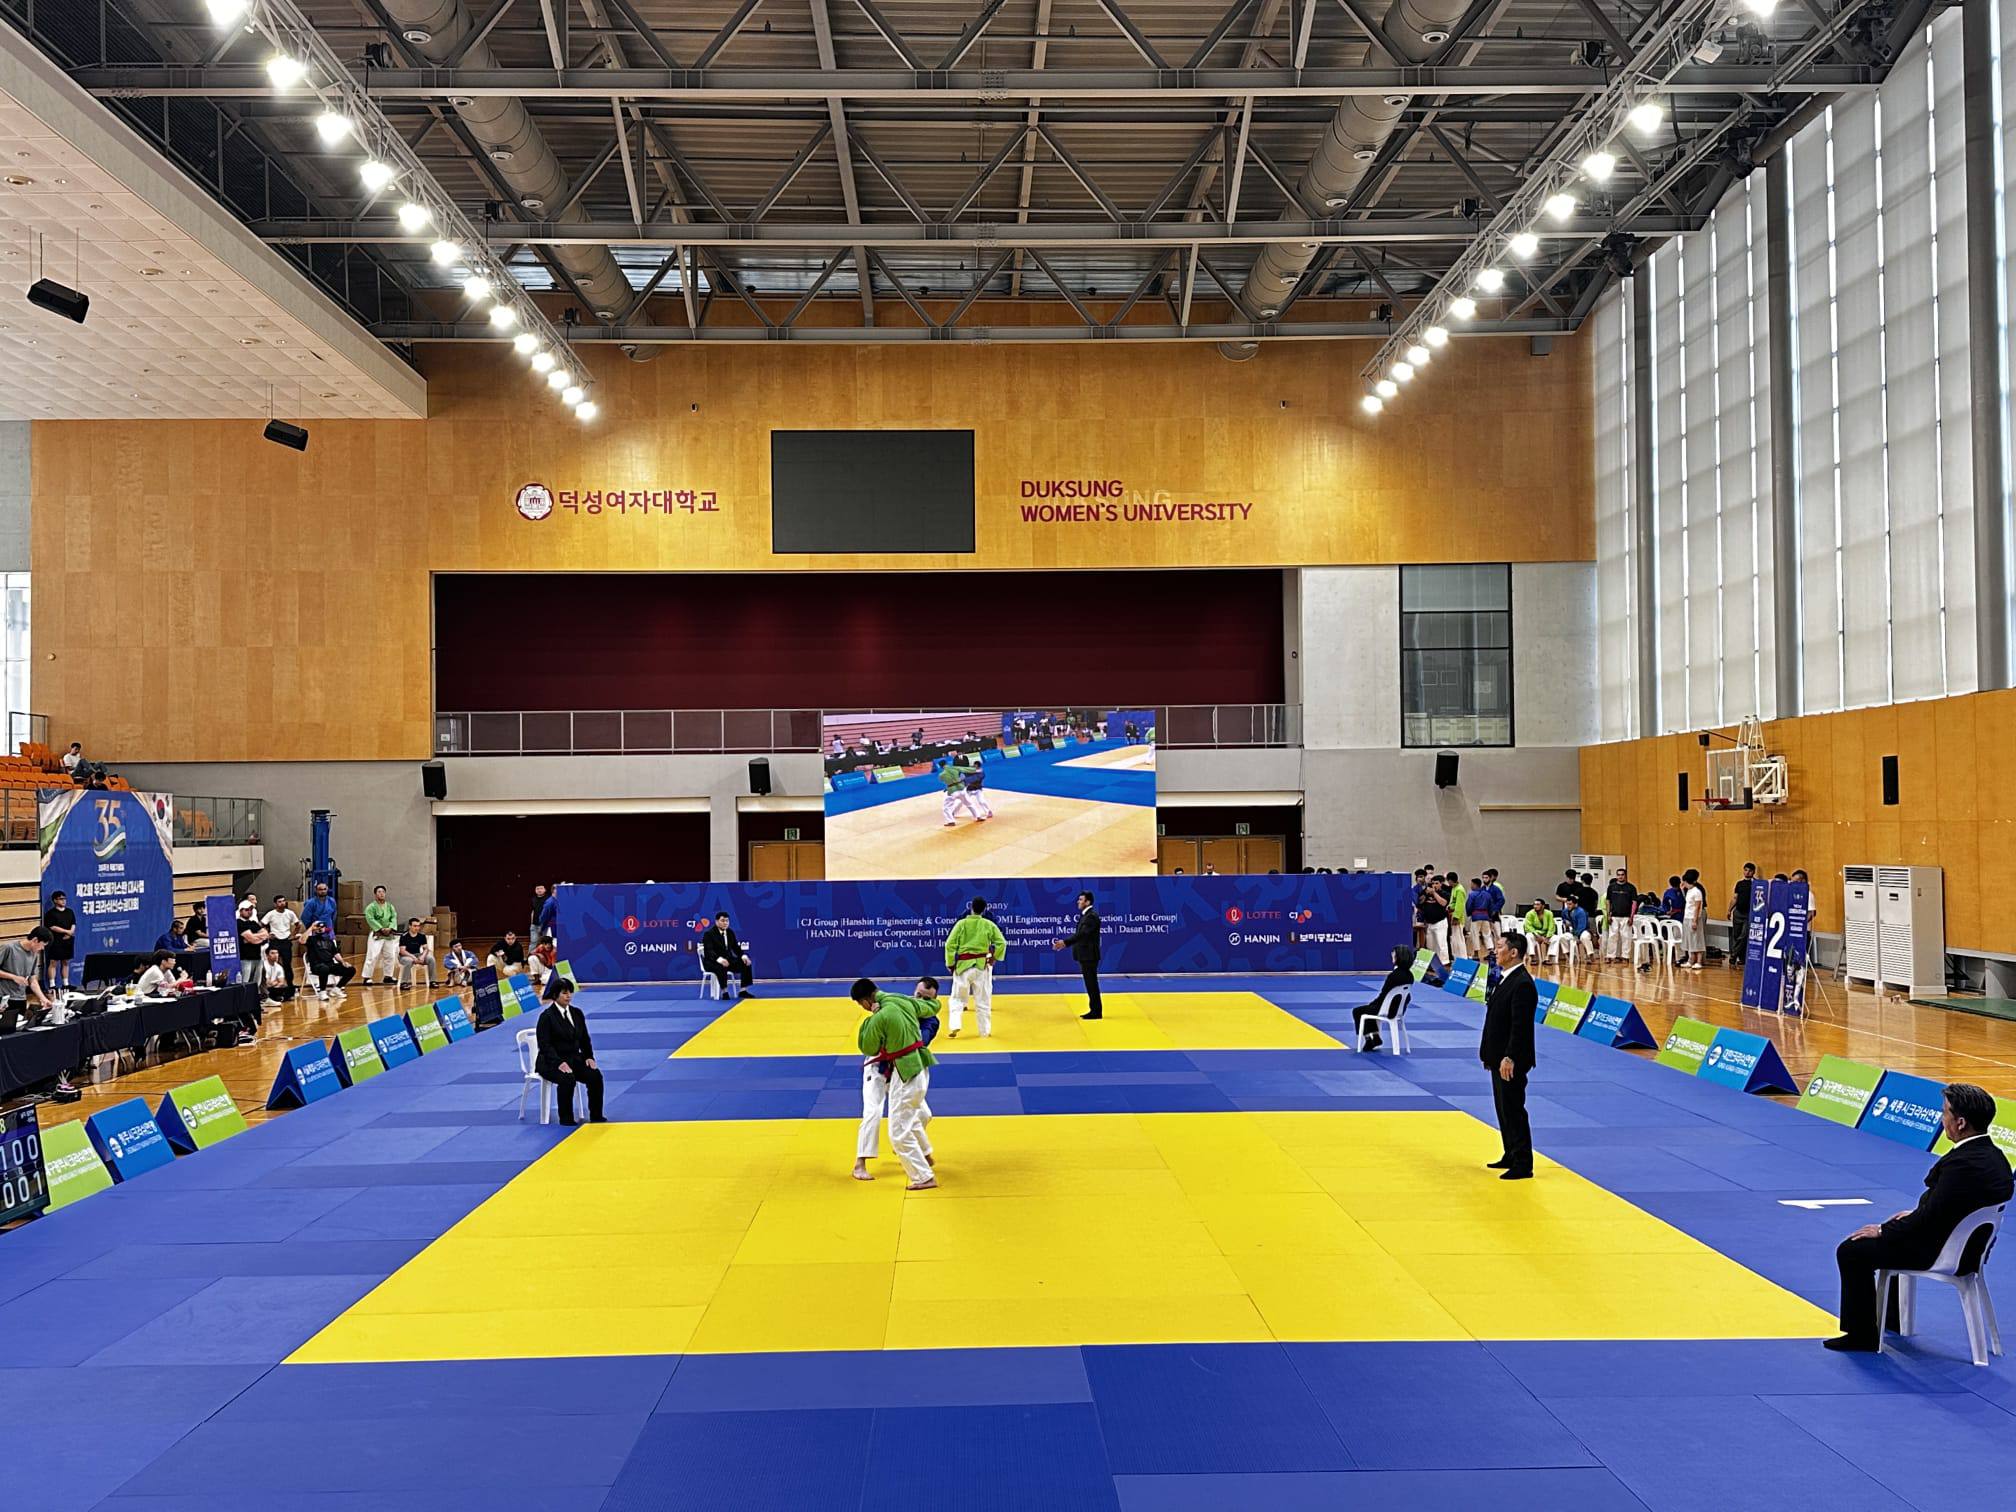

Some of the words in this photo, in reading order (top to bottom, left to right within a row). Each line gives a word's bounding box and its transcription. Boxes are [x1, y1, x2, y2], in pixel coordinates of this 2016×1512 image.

[1021, 480, 1123, 497] DUKSUNG
[559, 490, 720, 515] 덕성여자대학교
[1124, 503, 1252, 521] UNIVERSITY
[966, 901, 1008, 910] Cpany
[1015, 915, 1062, 924] Engineering
[1130, 913, 1150, 921] Lotte
[1246, 911, 1281, 919] LOTTE
[644, 920, 679, 928] LOTTE
[801, 918, 812, 926] CJ
[813, 918, 839, 928] Group
[876, 917, 923, 927] Engineering
[925, 916, 932, 924] &
[810, 929, 845, 937] HANJIN
[847, 929, 883, 939] Logistics
[884, 928, 931, 938] Corporation
[1005, 926, 1054, 935] International
[1119, 925, 1144, 933] Dasan
[1767, 912, 1785, 958] 2
[1021, 937, 1050, 947] Airport
[1244, 934, 1280, 944] HANJIN
[640, 943, 677, 953] HANJIN
